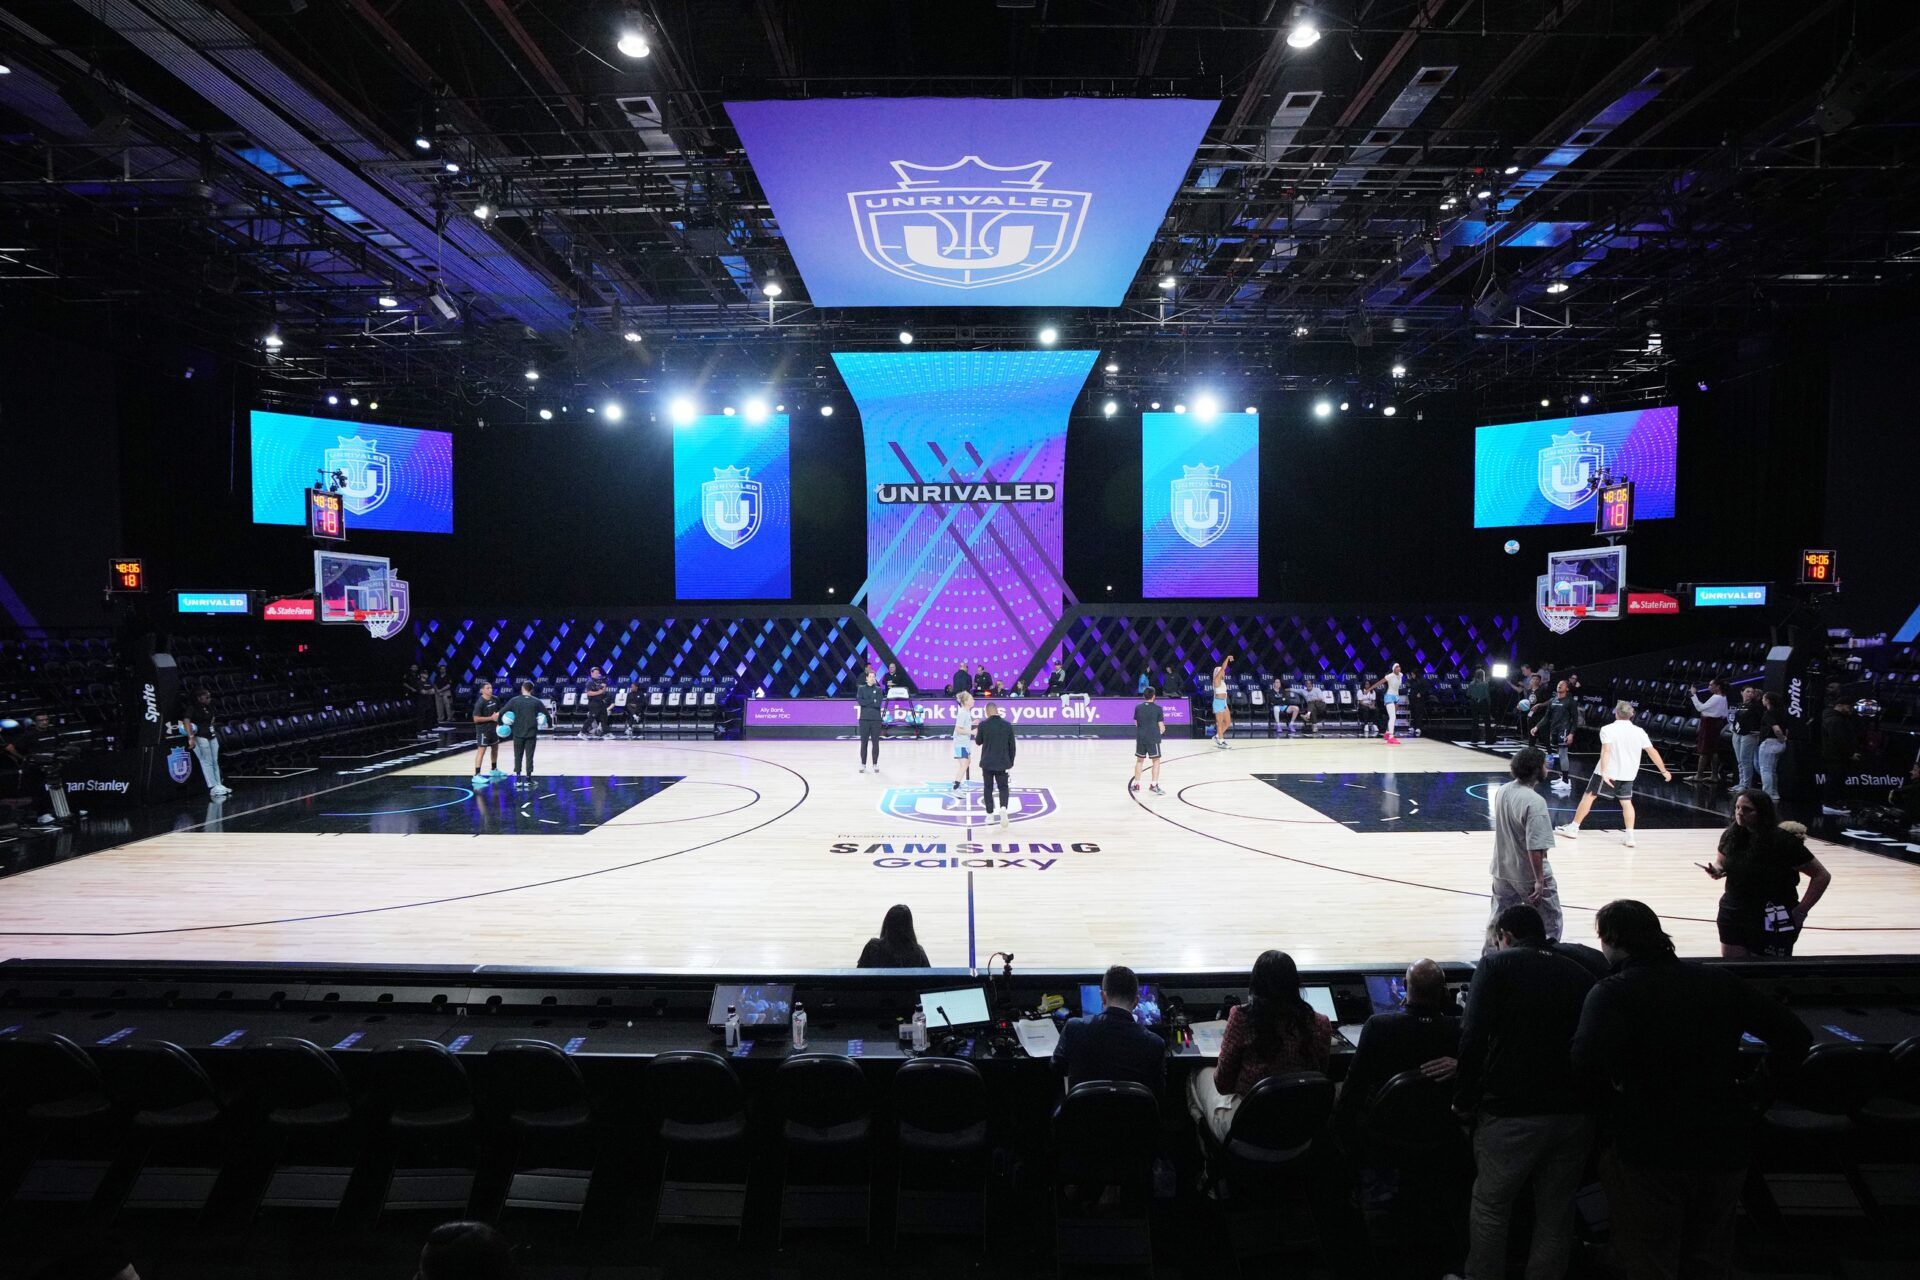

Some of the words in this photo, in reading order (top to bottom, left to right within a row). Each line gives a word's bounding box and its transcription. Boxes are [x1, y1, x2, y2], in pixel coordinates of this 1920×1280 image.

[866, 194, 1073, 208] UNRIVALED
[878, 484, 1054, 502] UNRIVALED
[1603, 488, 1627, 503] 48:06
[313, 495, 338, 511] 48:06
[322, 510, 337, 534] 18
[1610, 503, 1625, 526] 18
[1806, 555, 1829, 565] 48:06
[115, 563, 140, 573] 48:06
[1813, 566, 1825, 578] 18
[124, 574, 137, 587] 18
[183, 598, 244, 606] UNRIVALED
[1700, 591, 1762, 600] UNRIVALED
[143, 683, 160, 723] Sprite
[1788, 678, 1802, 718] Sprite
[894, 704, 946, 720] bnk
[1010, 706, 1057, 723] your
[1061, 702, 1100, 723] ally.
[86, 779, 129, 794] Stanley
[1815, 773, 1859, 786] Man
[1860, 773, 1904, 789] Stanley
[829, 842, 1102, 854] SAMSUNG
[872, 857, 1058, 871] Galaxy
